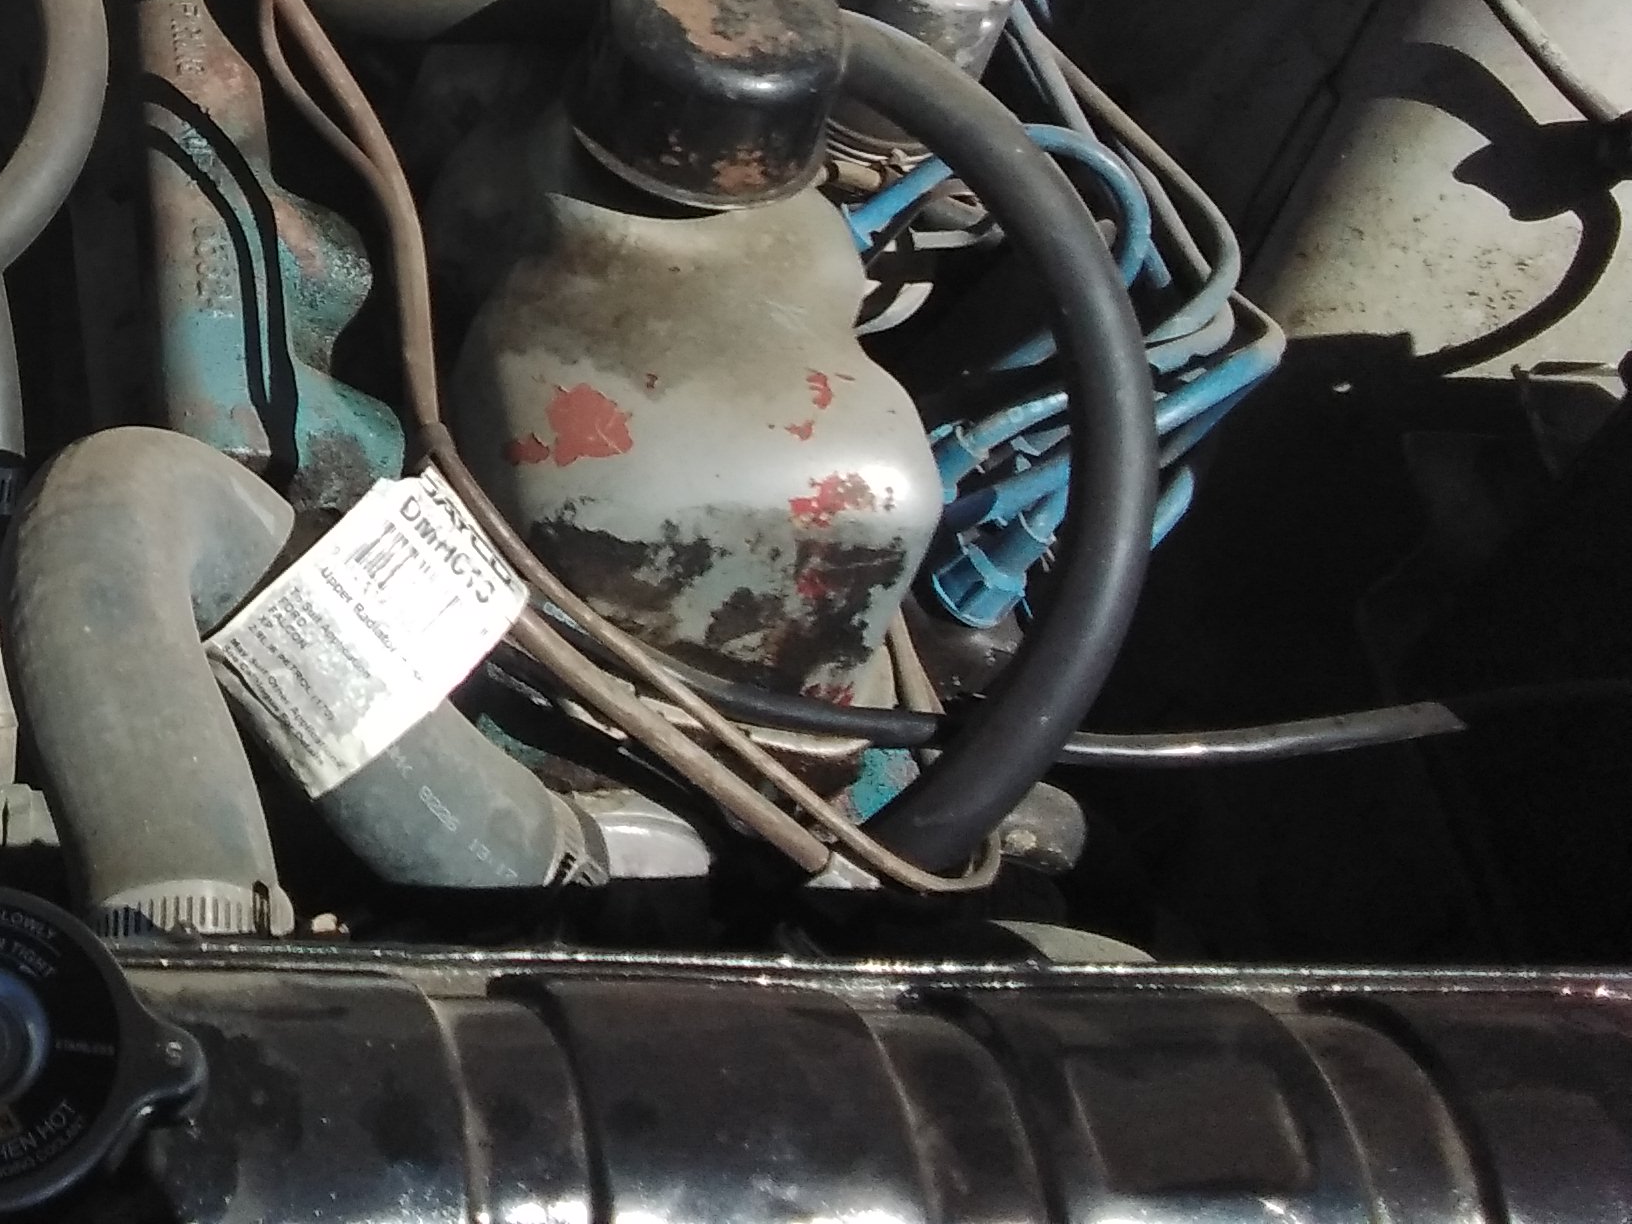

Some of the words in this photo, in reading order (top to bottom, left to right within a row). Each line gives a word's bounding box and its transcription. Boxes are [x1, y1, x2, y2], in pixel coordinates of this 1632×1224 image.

[318, 565, 354, 605] Upper
[257, 613, 274, 631] XP
[267, 604, 308, 651] FALCON
[277, 595, 307, 628] FORD
[300, 601, 323, 625] Suit
[229, 636, 250, 659] May
[264, 674, 293, 705] Other
[276, 650, 314, 694] PETROL
[11, 942, 56, 979] TIGHT
[36, 1098, 77, 1136] HOT
